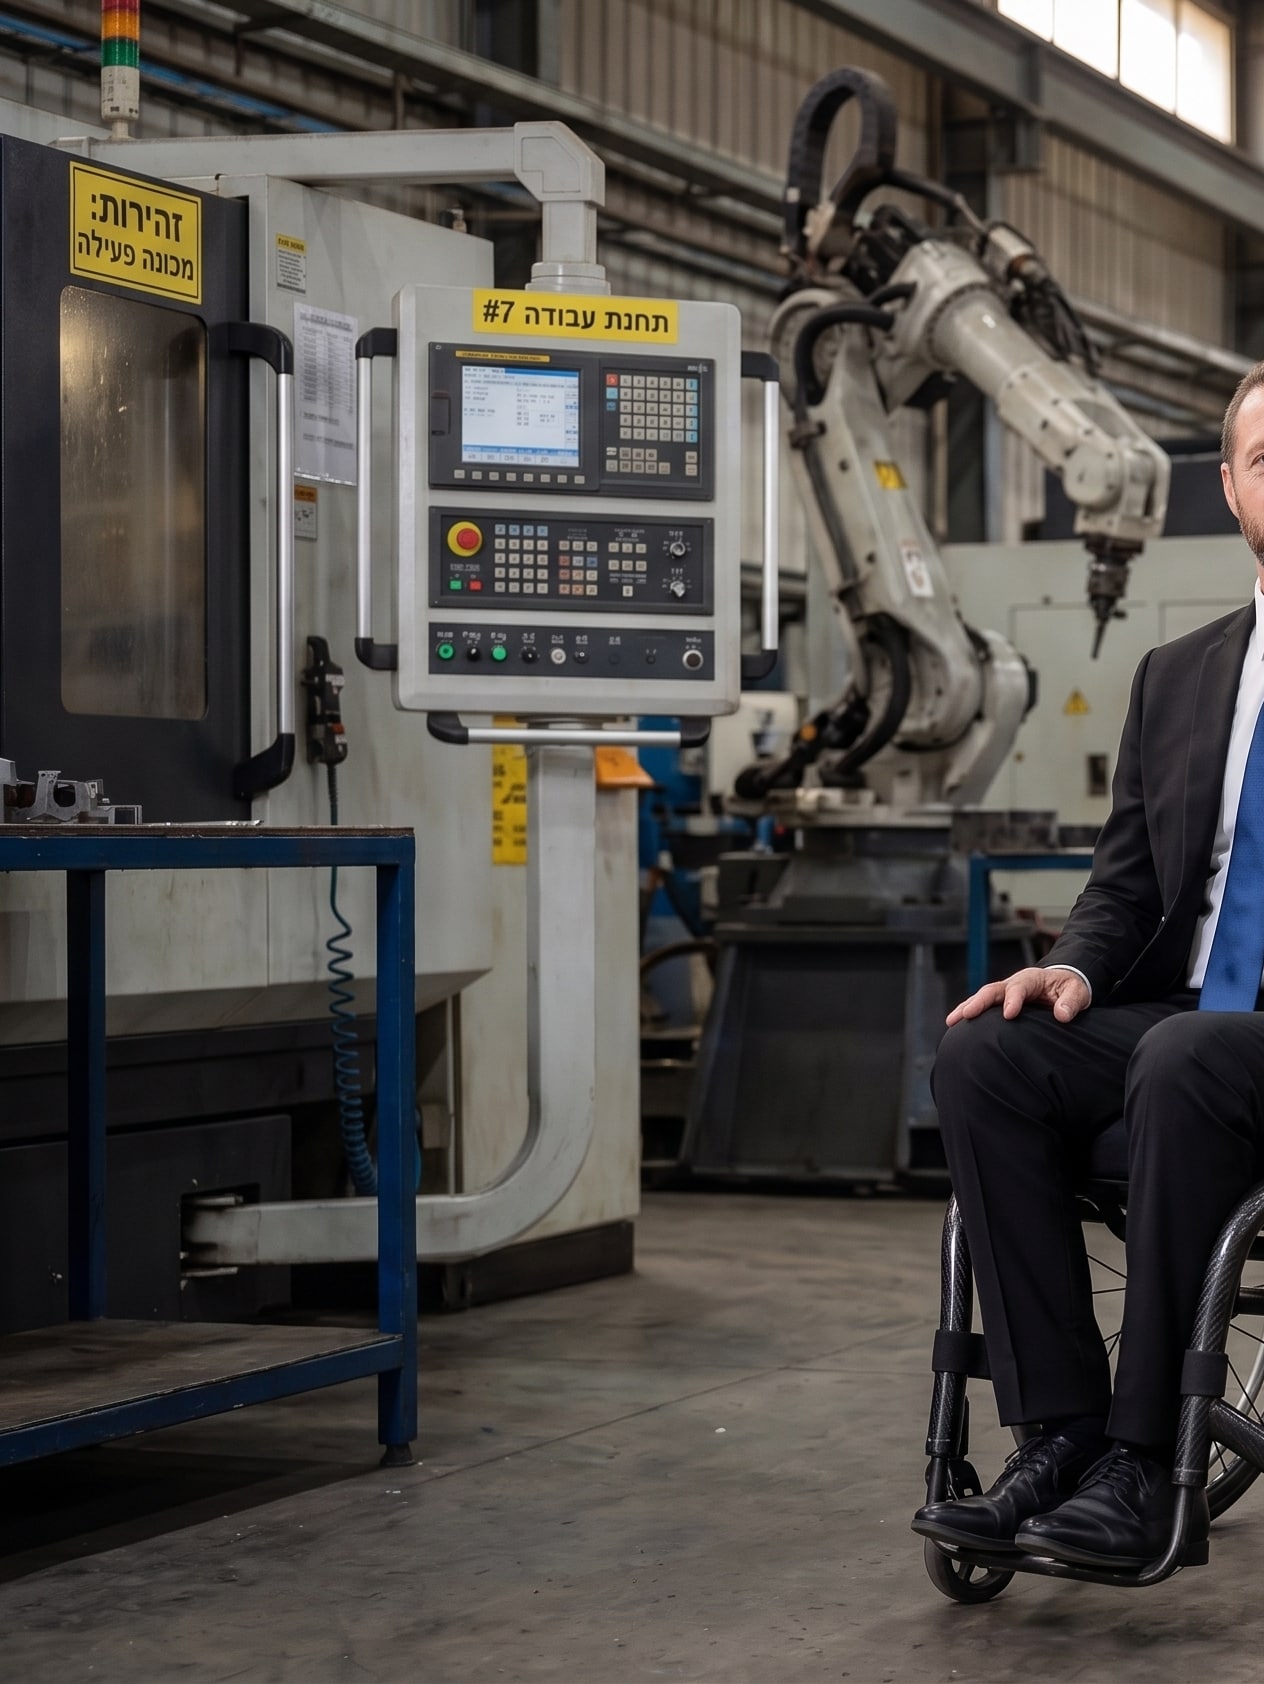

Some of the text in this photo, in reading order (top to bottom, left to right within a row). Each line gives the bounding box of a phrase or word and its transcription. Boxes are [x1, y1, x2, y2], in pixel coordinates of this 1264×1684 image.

[91, 193, 183, 243] זהירות:
[78, 228, 194, 281] מכונה פעילה
[483, 299, 669, 333] תחנת עבודה #7
